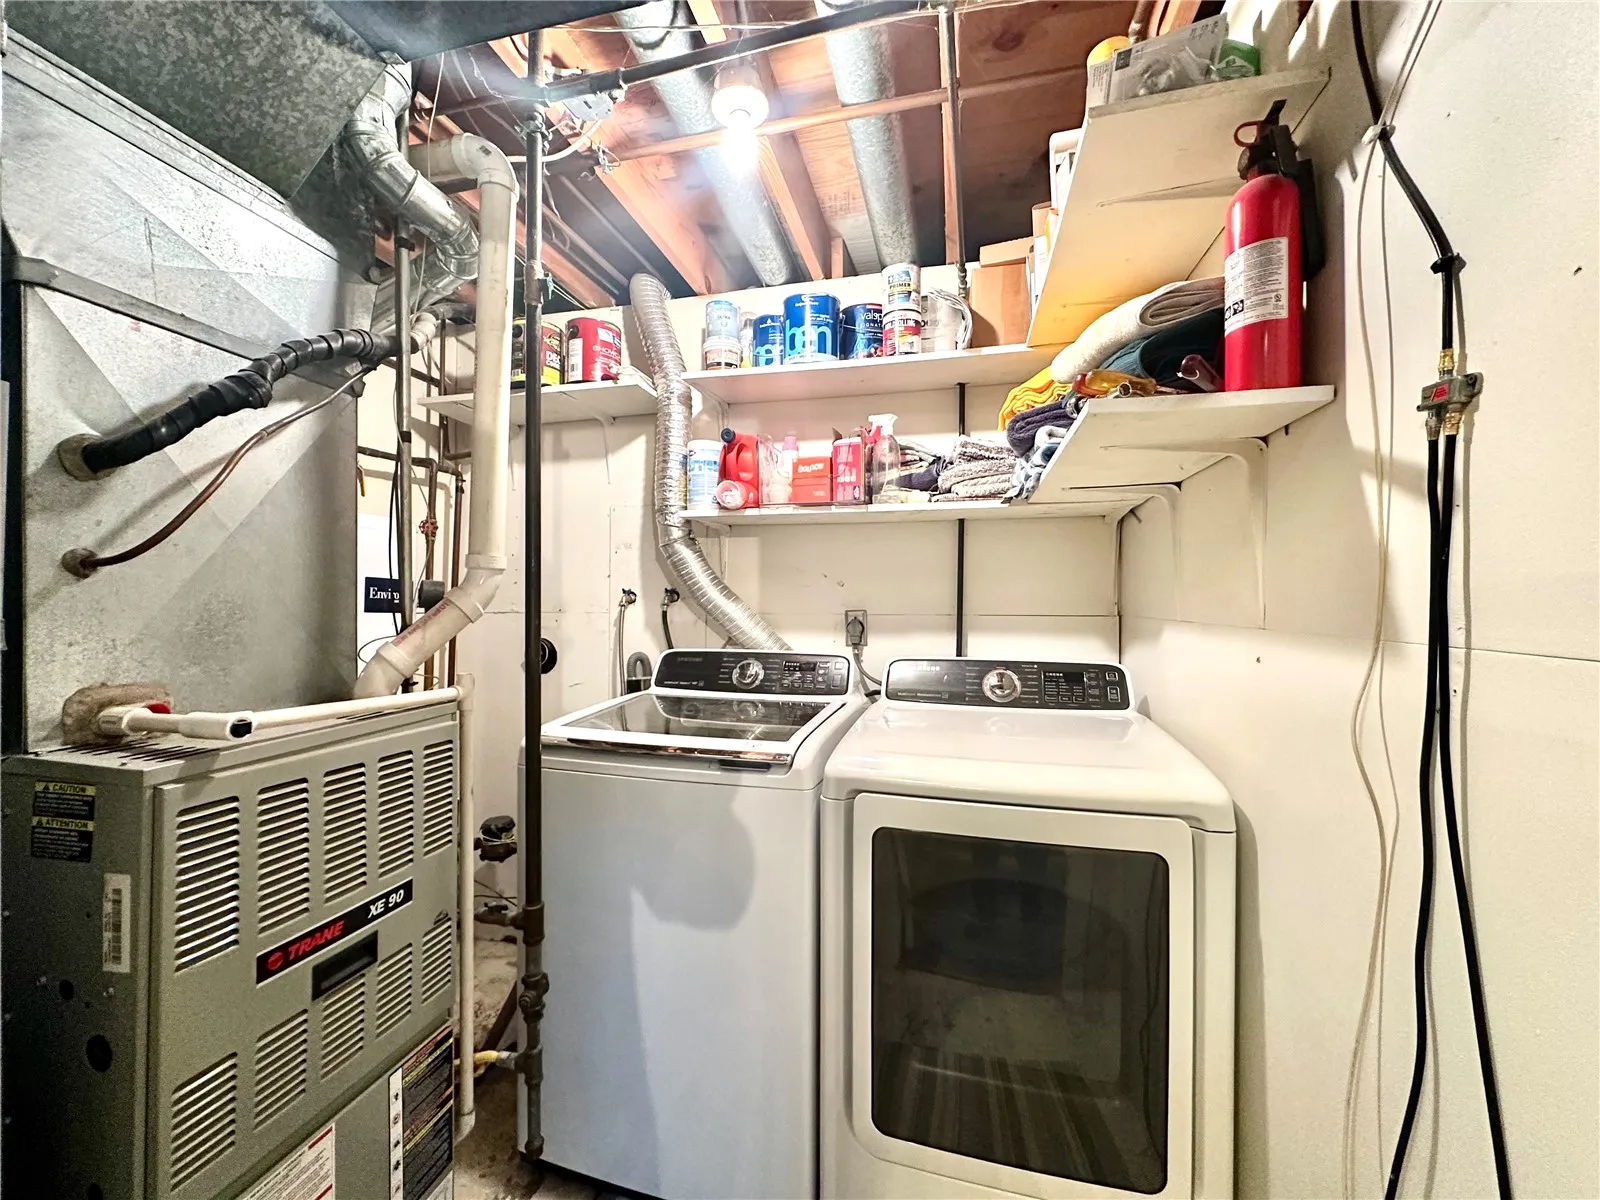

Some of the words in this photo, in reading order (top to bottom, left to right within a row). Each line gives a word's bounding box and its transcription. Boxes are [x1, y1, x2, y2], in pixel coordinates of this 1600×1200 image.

[889, 282, 911, 290] PRIMER
[53, 784, 86, 793] CAUTION
[45, 820, 88, 829] ATTENTION
[288, 920, 345, 960] TRANE
[368, 898, 387, 919] XE
[388, 889, 405, 907] 90
